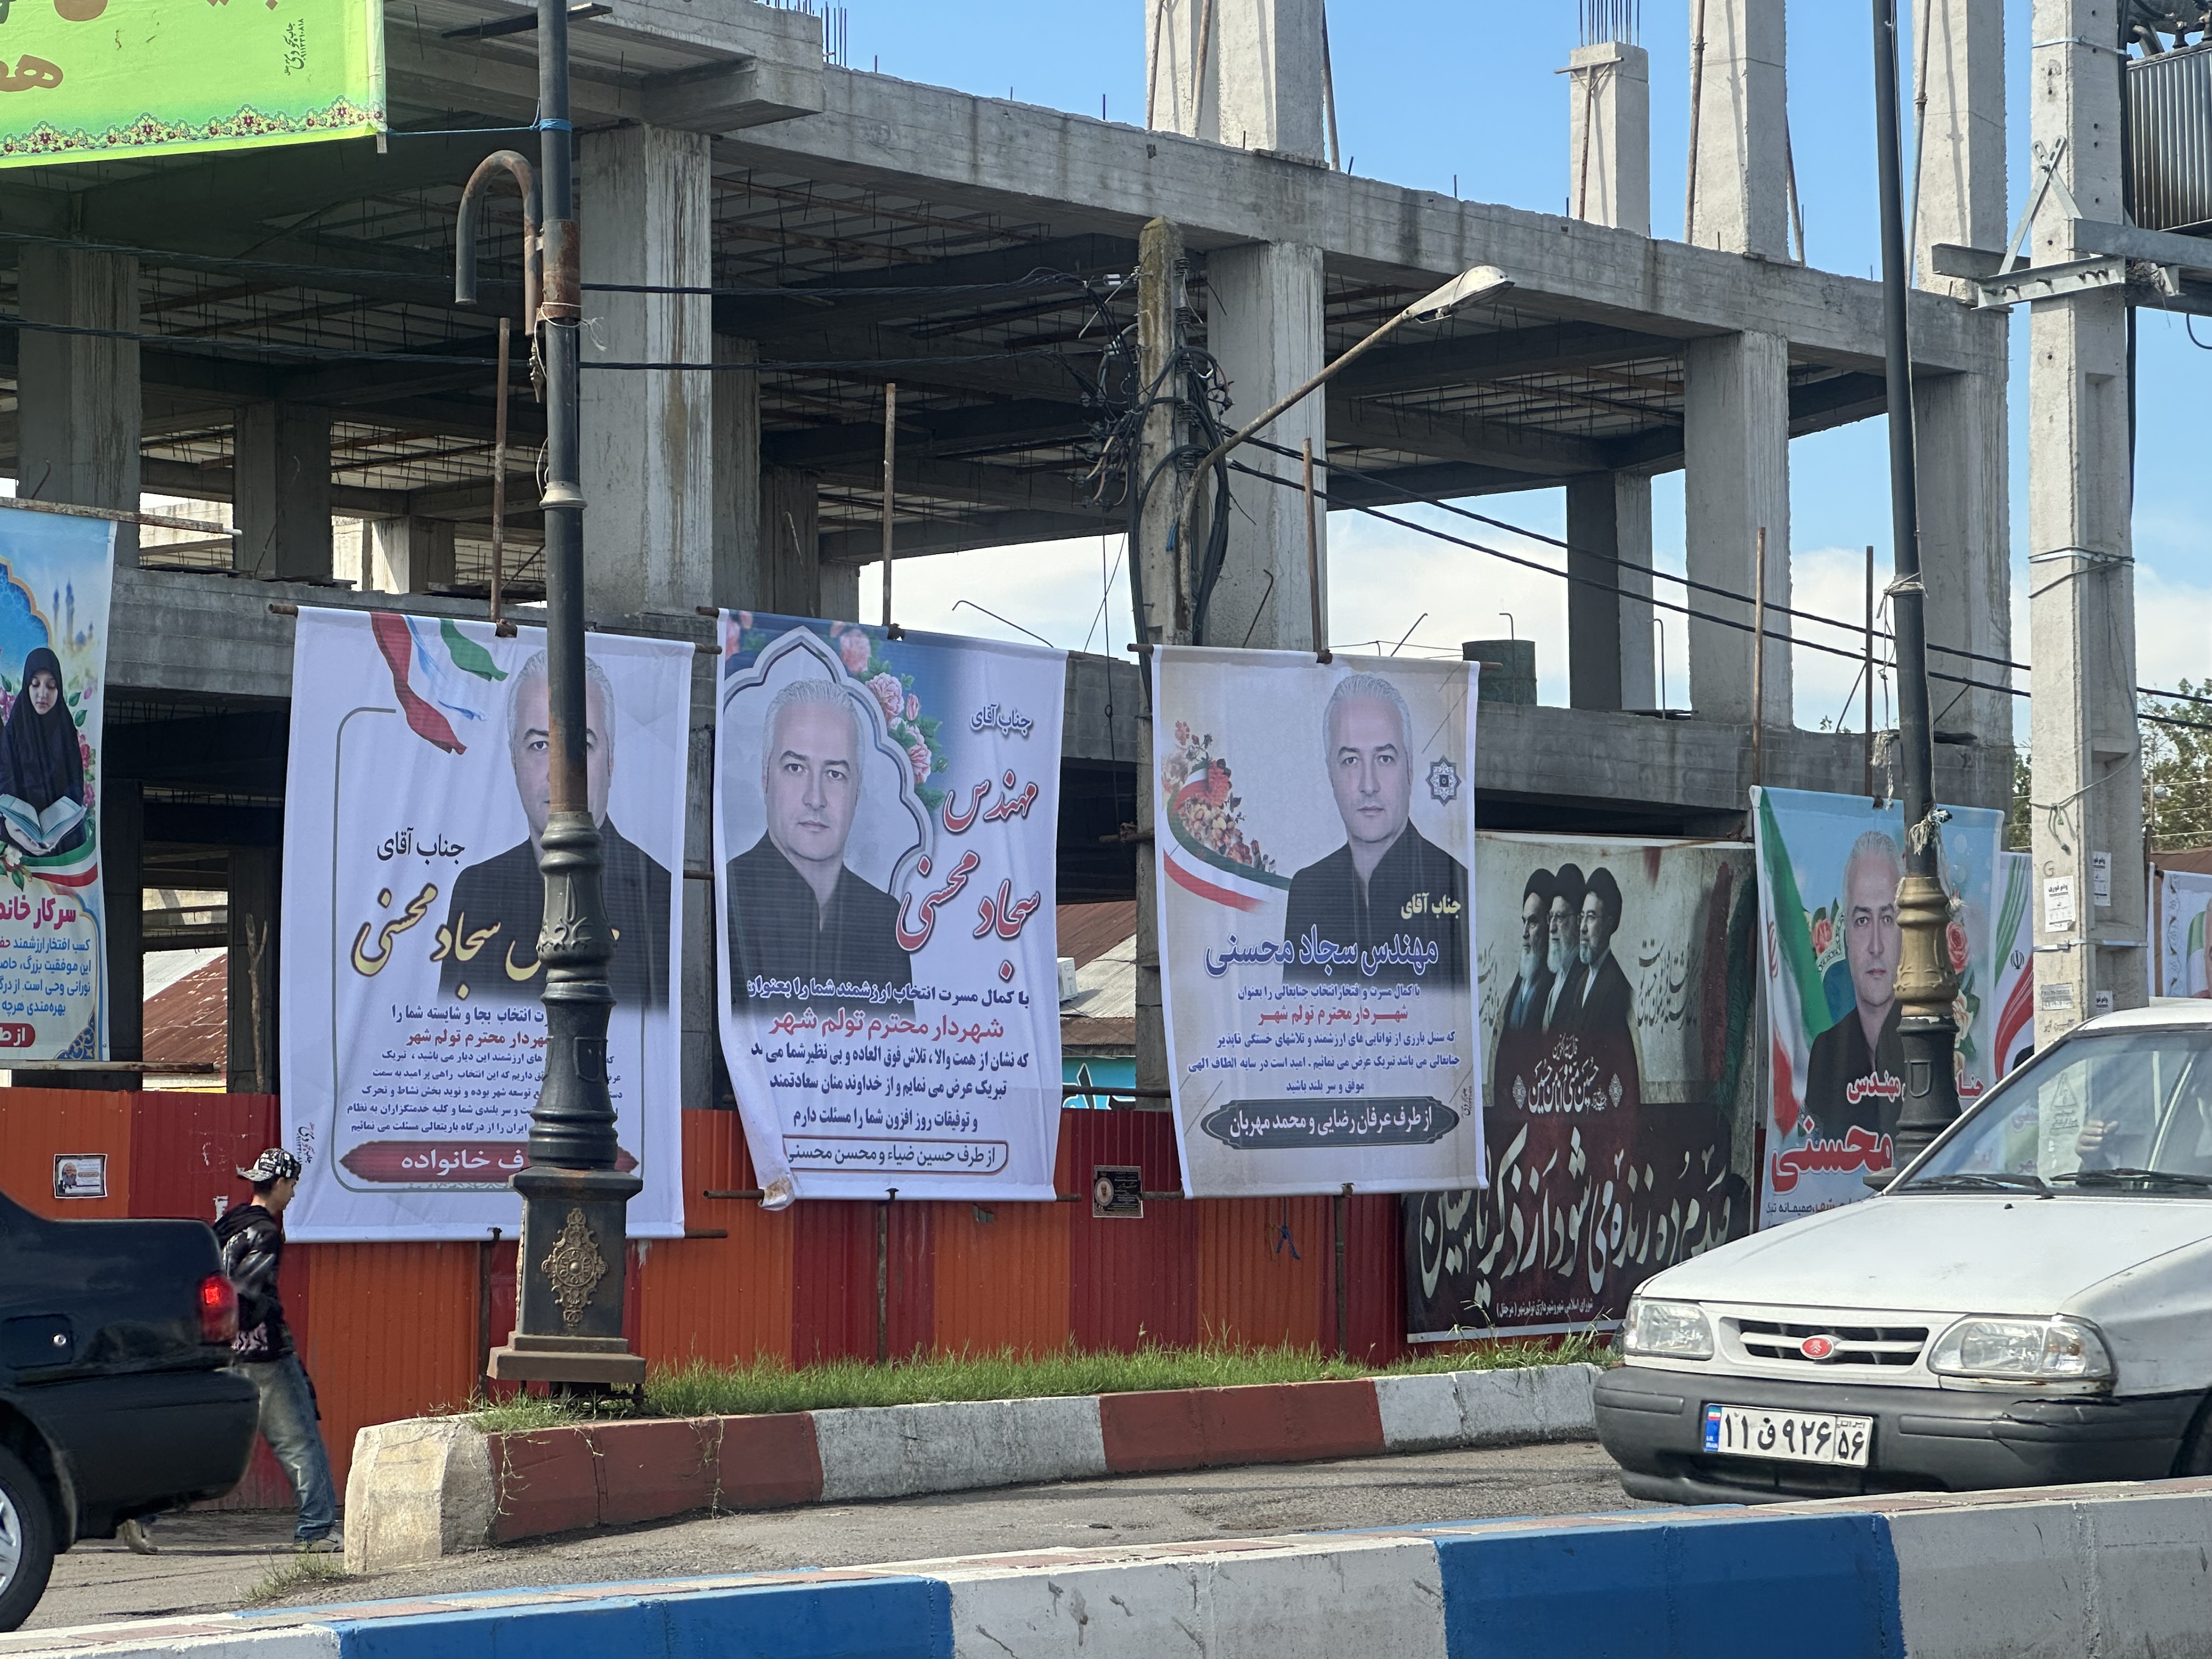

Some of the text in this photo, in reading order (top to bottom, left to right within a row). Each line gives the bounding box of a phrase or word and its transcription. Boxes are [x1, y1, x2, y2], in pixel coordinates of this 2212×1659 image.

[972, 703, 1032, 737] جناب آقای
[944, 770, 1037, 832] مهندس
[376, 827, 465, 865] جناب آقای
[33, 898, 76, 930] سرکار
[1401, 893, 1461, 919] جناب آقای
[896, 851, 1041, 983] سجاد محسنی
[351, 883, 438, 976] محسنی
[13, 935, 44, 953] ارزشمند
[47, 937, 70, 953] افتخار
[72, 939, 90, 954] کسب
[1205, 925, 1438, 977] مهندس سجاد محسنی
[431, 912, 501, 1000] سجاد
[44, 960, 78, 975] موفقیت
[80, 960, 91, 975] این
[13, 978, 20, 994] از
[45, 983, 64, 996] وحی
[66, 980, 91, 996] نورانی
[747, 975, 1014, 1007] کمال مسرت انتخاب ارزشمند شما بعنوان
[1238, 984, 1414, 1001] کمال مسرت انتخاب جنابعالی بعنوان
[2, 1000, 24, 1017] هرچه
[426, 1006, 461, 1023] شایسته
[497, 1007, 531, 1025] انتخاب
[1258, 1004, 1408, 1026] شهردار محترم تولم شهر
[768, 1007, 1004, 1043] شهردار محترم تولم شهر
[14, 1026, 26, 1046] از
[406, 1028, 431, 1046] شهر
[435, 1028, 461, 1047] تولم
[465, 1031, 505, 1047] محترم
[1216, 1031, 1445, 1048] سنبل بارزی توانایی ارزشمند تلاشهای خستگی ناپذیر
[382, 1049, 524, 1064] ارزشمند دیار تبریک
[805, 1043, 1015, 1071] نشان تلاش العاده نظیر
[1188, 1054, 1460, 1073] جنابعالی باشد تبریک امید سایه الطاف الهی
[404, 1069, 421, 1079] امید
[432, 1070, 453, 1080] راهی
[458, 1070, 484, 1079] انتخاب
[512, 1071, 532, 1082] داریم
[362, 1085, 388, 1097] تحرک
[397, 1086, 419, 1095] نشاط
[443, 1086, 461, 1097] نوید
[471, 1088, 489, 1097] بوده
[509, 1088, 531, 1097] توسعه
[821, 1073, 843, 1094] منان
[845, 1074, 882, 1096] خداوند
[903, 1076, 926, 1097] نمایم
[975, 1079, 1007, 1100] تبریک
[1286, 1079, 1364, 1094] موفق بلند باشید
[1847, 1070, 1901, 1104] مهندس
[347, 1103, 498, 1115] بلندی کلیه نظام
[351, 1120, 527, 1134] ایران درگاه باریتعالی مسئلت نمائیم
[793, 1106, 970, 1132] توفیقات روز افزون شما مسئلت دارم
[1229, 1106, 1421, 1138] طرف عرفان رضایی محمد مهربان
[401, 1149, 490, 1176] خانواده
[835, 1144, 984, 1167] طرف حسین ضیاء محسن
[1770, 1115, 1893, 1195] محسنی
[1725, 1414, 1748, 1449] ۱۱
[1782, 1419, 1832, 1455] ۹۲۶
[1838, 1430, 1864, 1460] ۵۶
